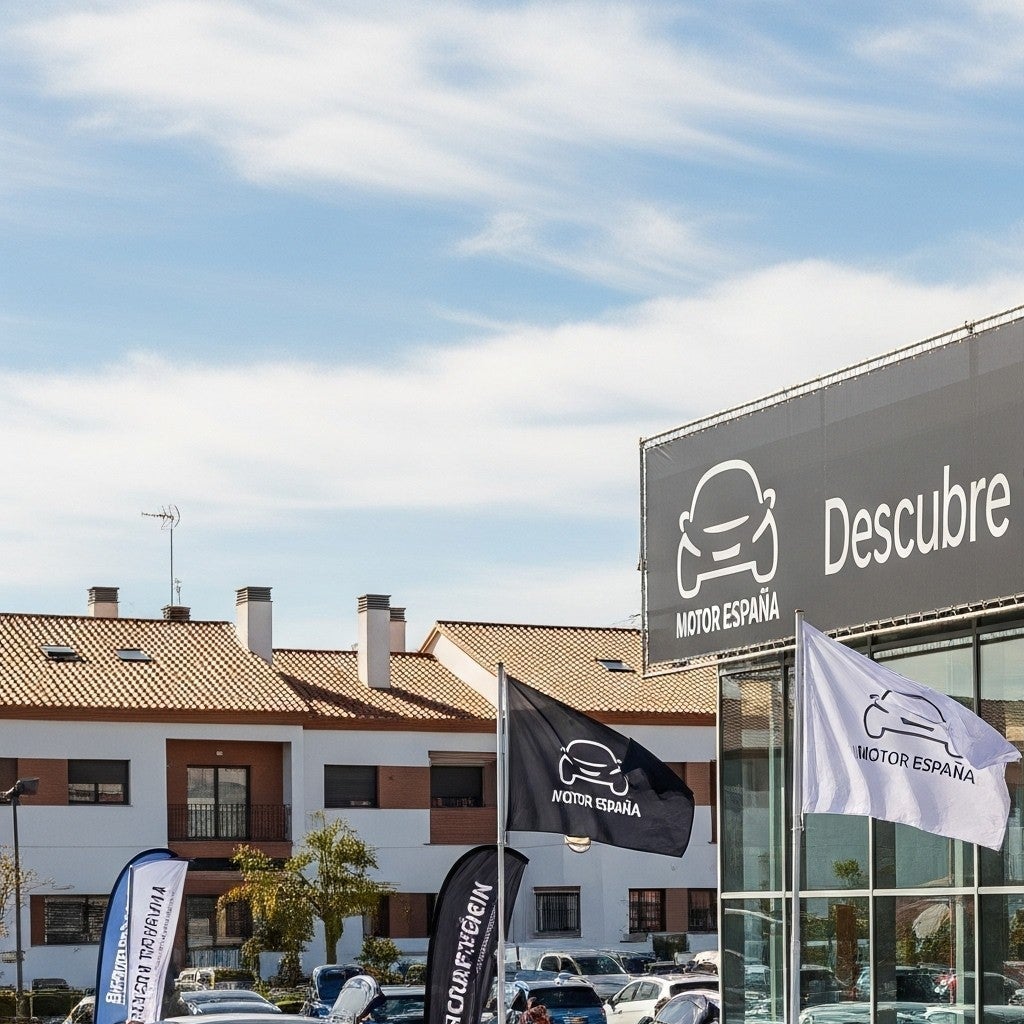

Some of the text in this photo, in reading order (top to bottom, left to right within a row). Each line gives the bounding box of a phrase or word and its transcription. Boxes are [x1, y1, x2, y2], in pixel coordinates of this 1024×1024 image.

[824, 465, 1011, 576] Descubre
[676, 587, 780, 639] MOTOR ESPAÑA
[912, 755, 976, 785] ESPAÑA
[595, 797, 641, 818] ESPAÑA
